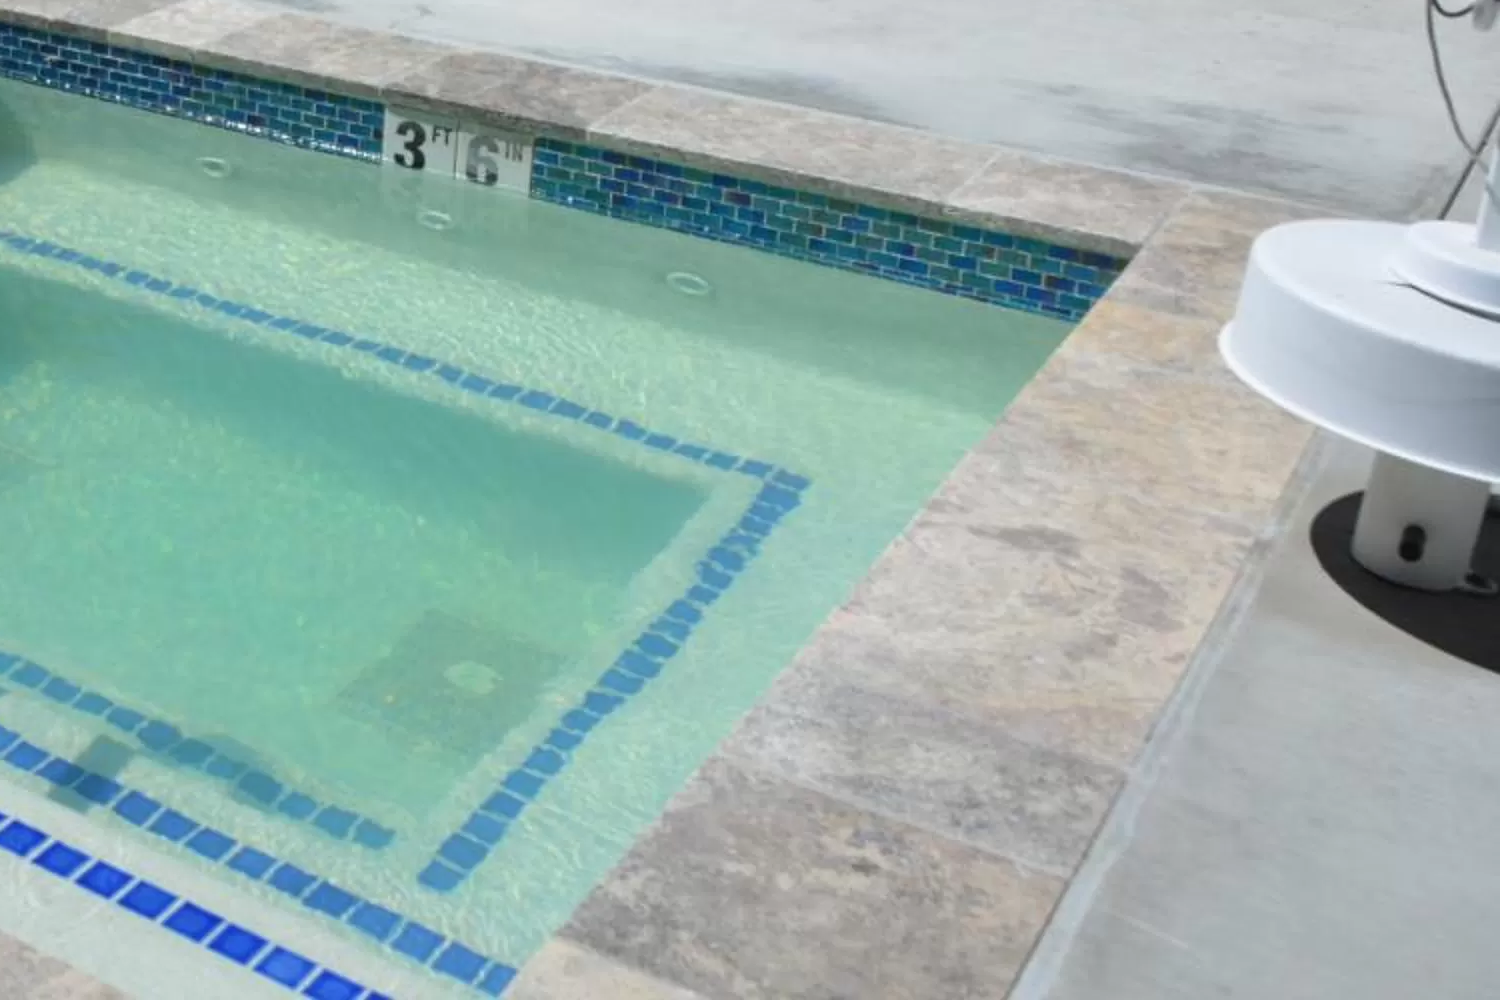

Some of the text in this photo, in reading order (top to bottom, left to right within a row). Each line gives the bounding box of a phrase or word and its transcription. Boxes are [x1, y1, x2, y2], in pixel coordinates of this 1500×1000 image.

[393, 121, 426, 170] 3
[431, 124, 453, 146] FT
[466, 134, 499, 186] 6
